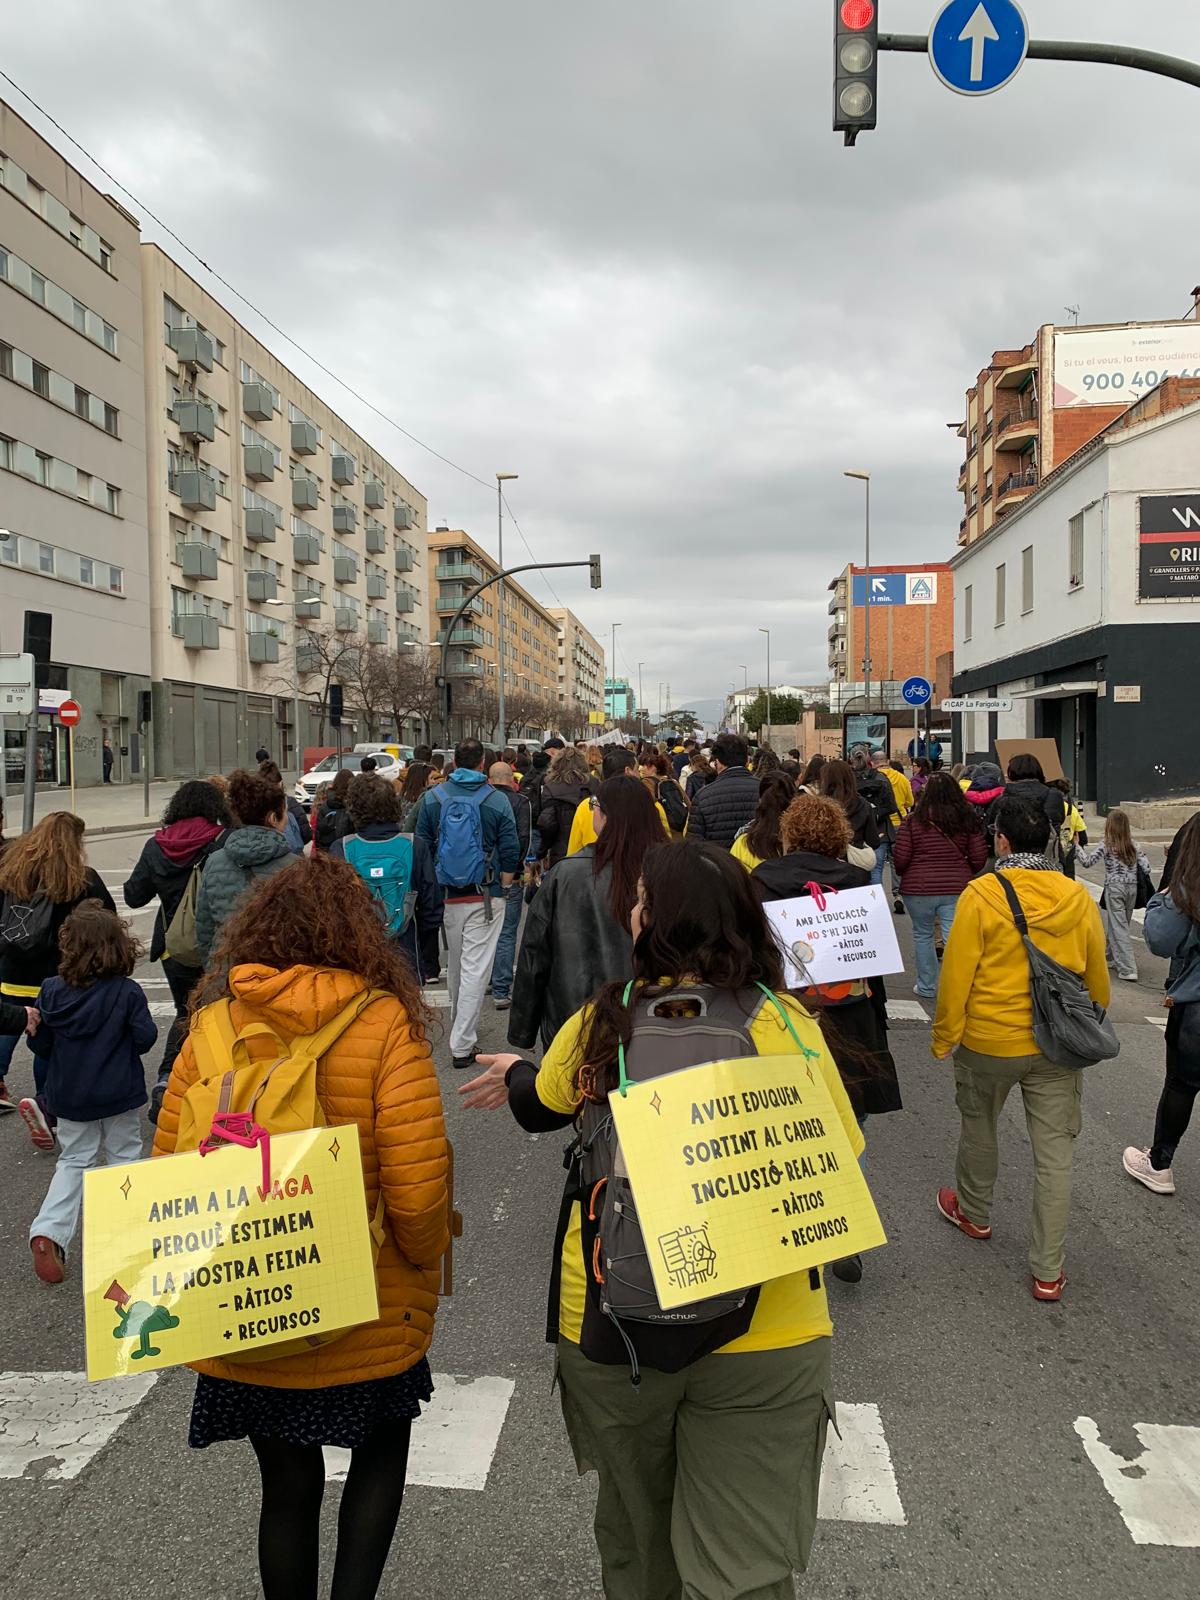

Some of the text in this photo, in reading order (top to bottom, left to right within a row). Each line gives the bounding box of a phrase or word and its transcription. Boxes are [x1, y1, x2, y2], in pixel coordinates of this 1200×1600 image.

[1124, 355, 1133, 363] la
[1082, 372, 1125, 391] 900
[1154, 566, 1190, 574] GRANOLLERS
[975, 701, 1000, 709] Farigola
[796, 917, 813, 927] AMB
[806, 931, 820, 941] NO
[839, 939, 864, 949] RÀTIOS
[843, 950, 877, 962] RECURSOS
[690, 1086, 803, 1125] AVUI EDUQUEM
[682, 1117, 826, 1166] SORTINT AL CARRER
[691, 1160, 783, 1205] INCLUSIÓ
[785, 1156, 818, 1182] REAL
[149, 1174, 314, 1222] ANEM A LA VAGA
[782, 1190, 825, 1217] RÀTIOS
[152, 1210, 314, 1259] PERQUÈ ESTIMEM
[791, 1216, 849, 1248] RECURSOS
[152, 1243, 322, 1297] LA NOSTRA FEINA
[233, 1284, 294, 1312] RÀTIOS
[238, 1307, 321, 1341] RECURSOS
